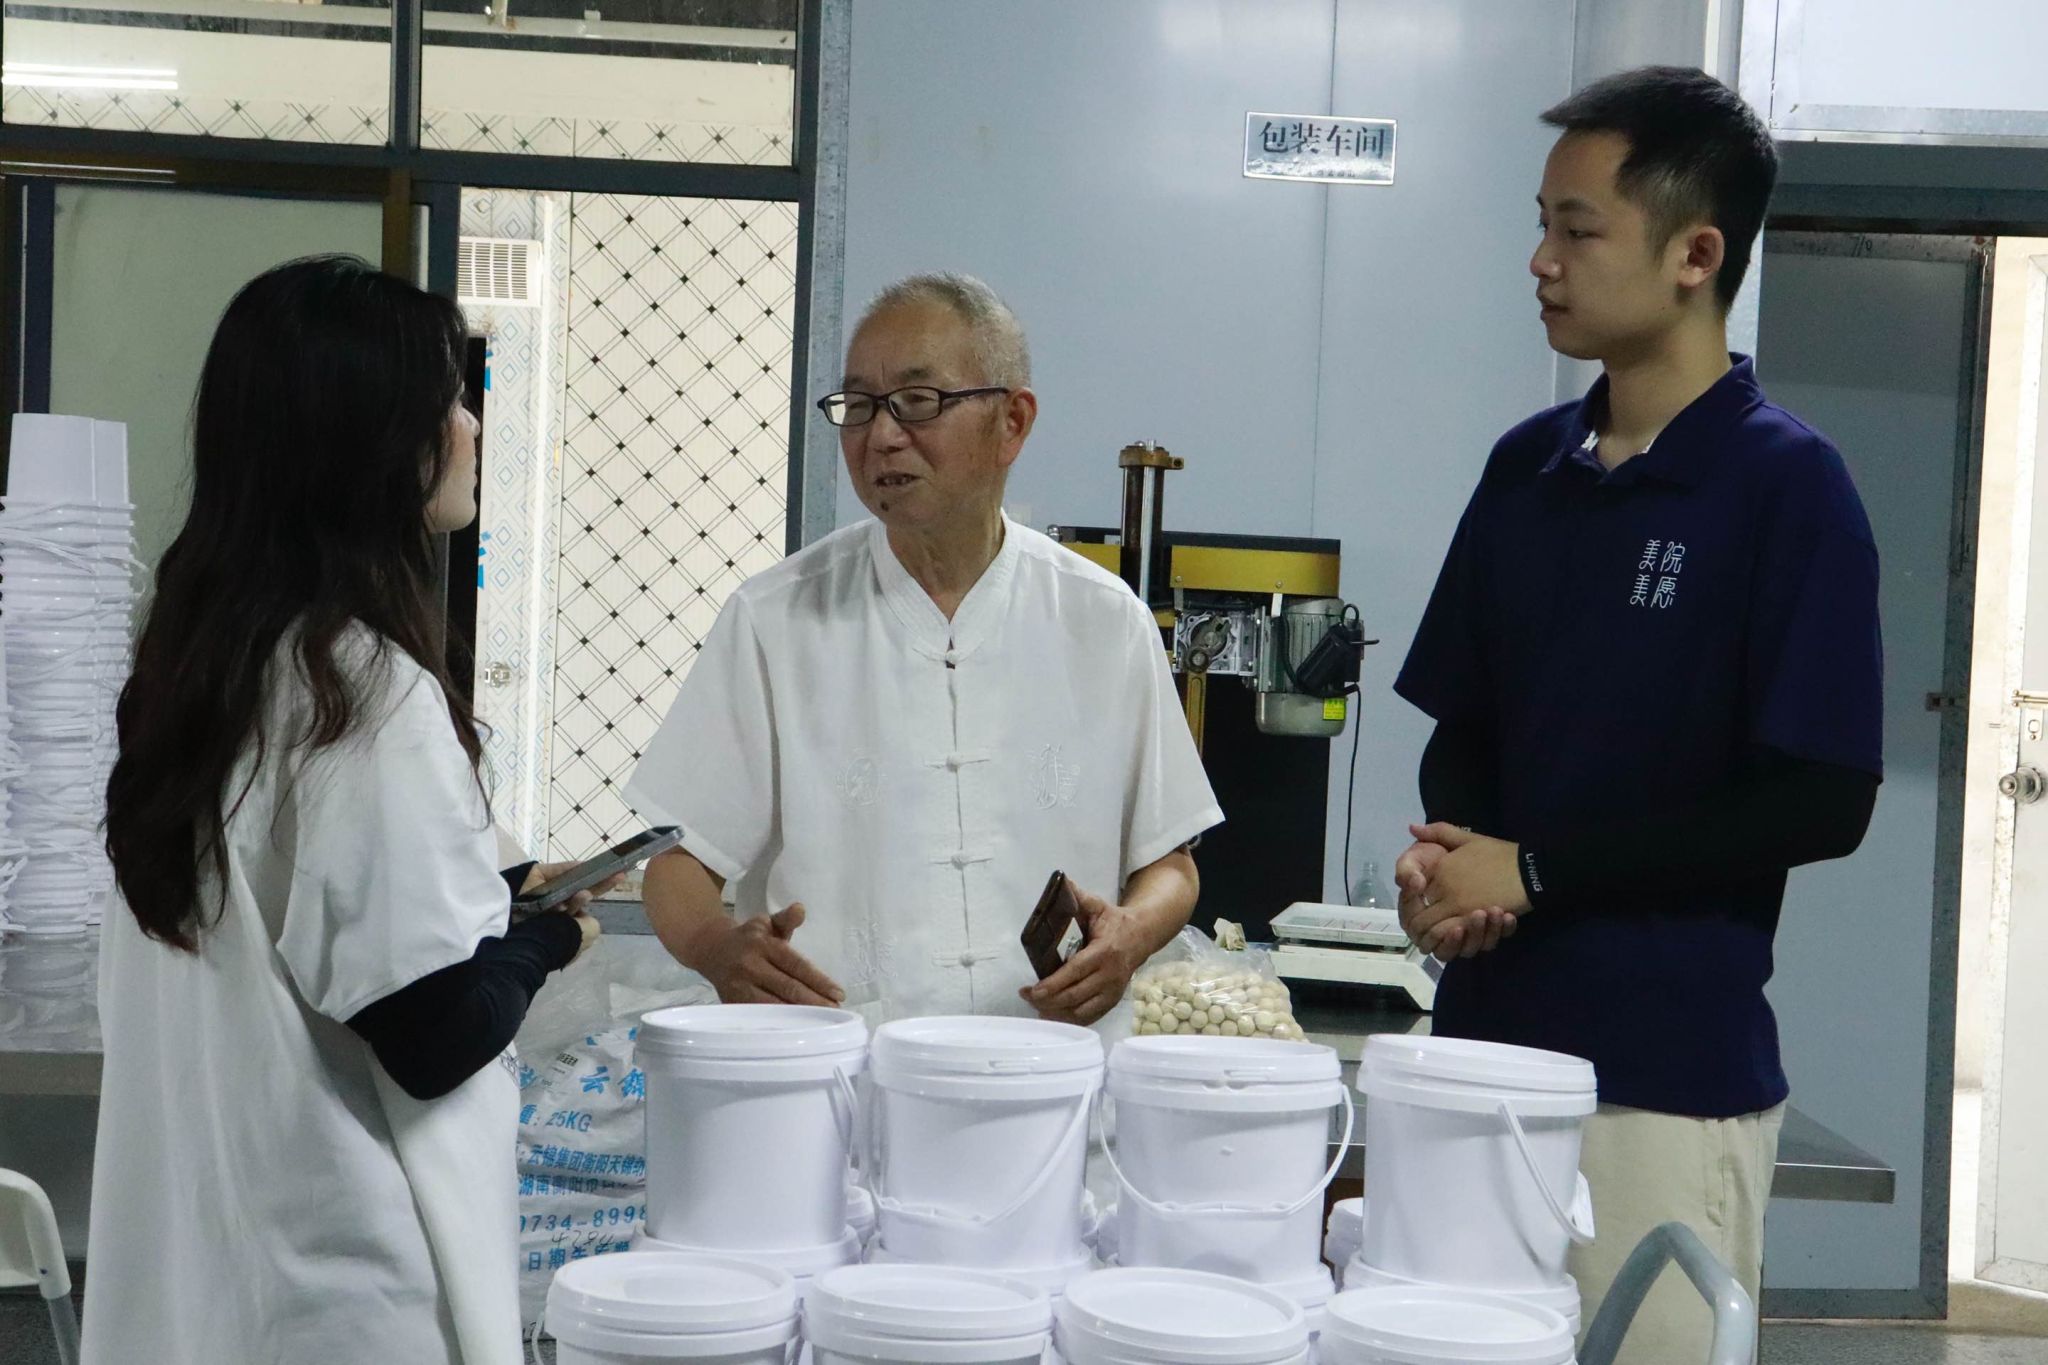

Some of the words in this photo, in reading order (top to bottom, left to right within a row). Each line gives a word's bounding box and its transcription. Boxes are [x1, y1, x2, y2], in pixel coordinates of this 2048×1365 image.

[1259, 121, 1385, 159] 包装车间
[545, 1109, 592, 1133] 25KG
